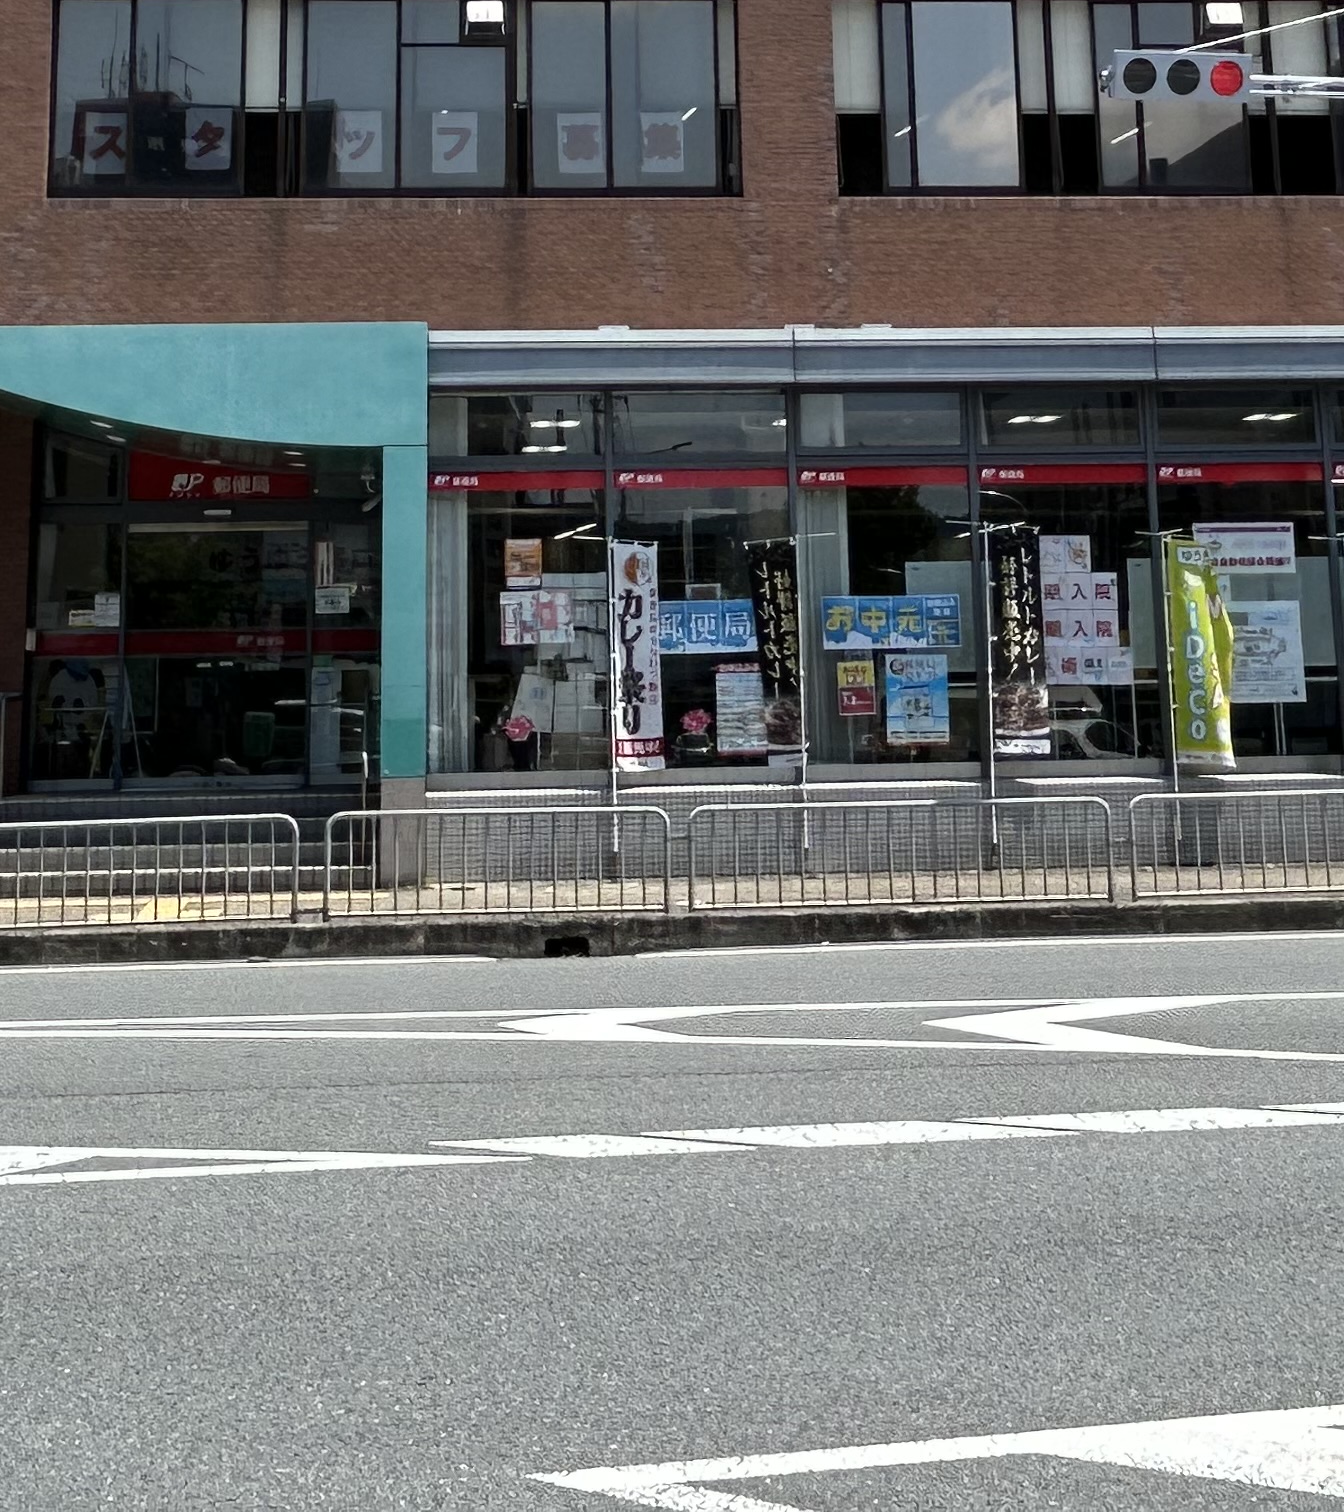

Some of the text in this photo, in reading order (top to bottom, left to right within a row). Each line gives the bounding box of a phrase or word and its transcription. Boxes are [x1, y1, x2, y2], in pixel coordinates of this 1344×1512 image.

[659, 612, 751, 641] 郵便局
[826, 605, 922, 634] お中元
[618, 589, 646, 734] カレー祭り
